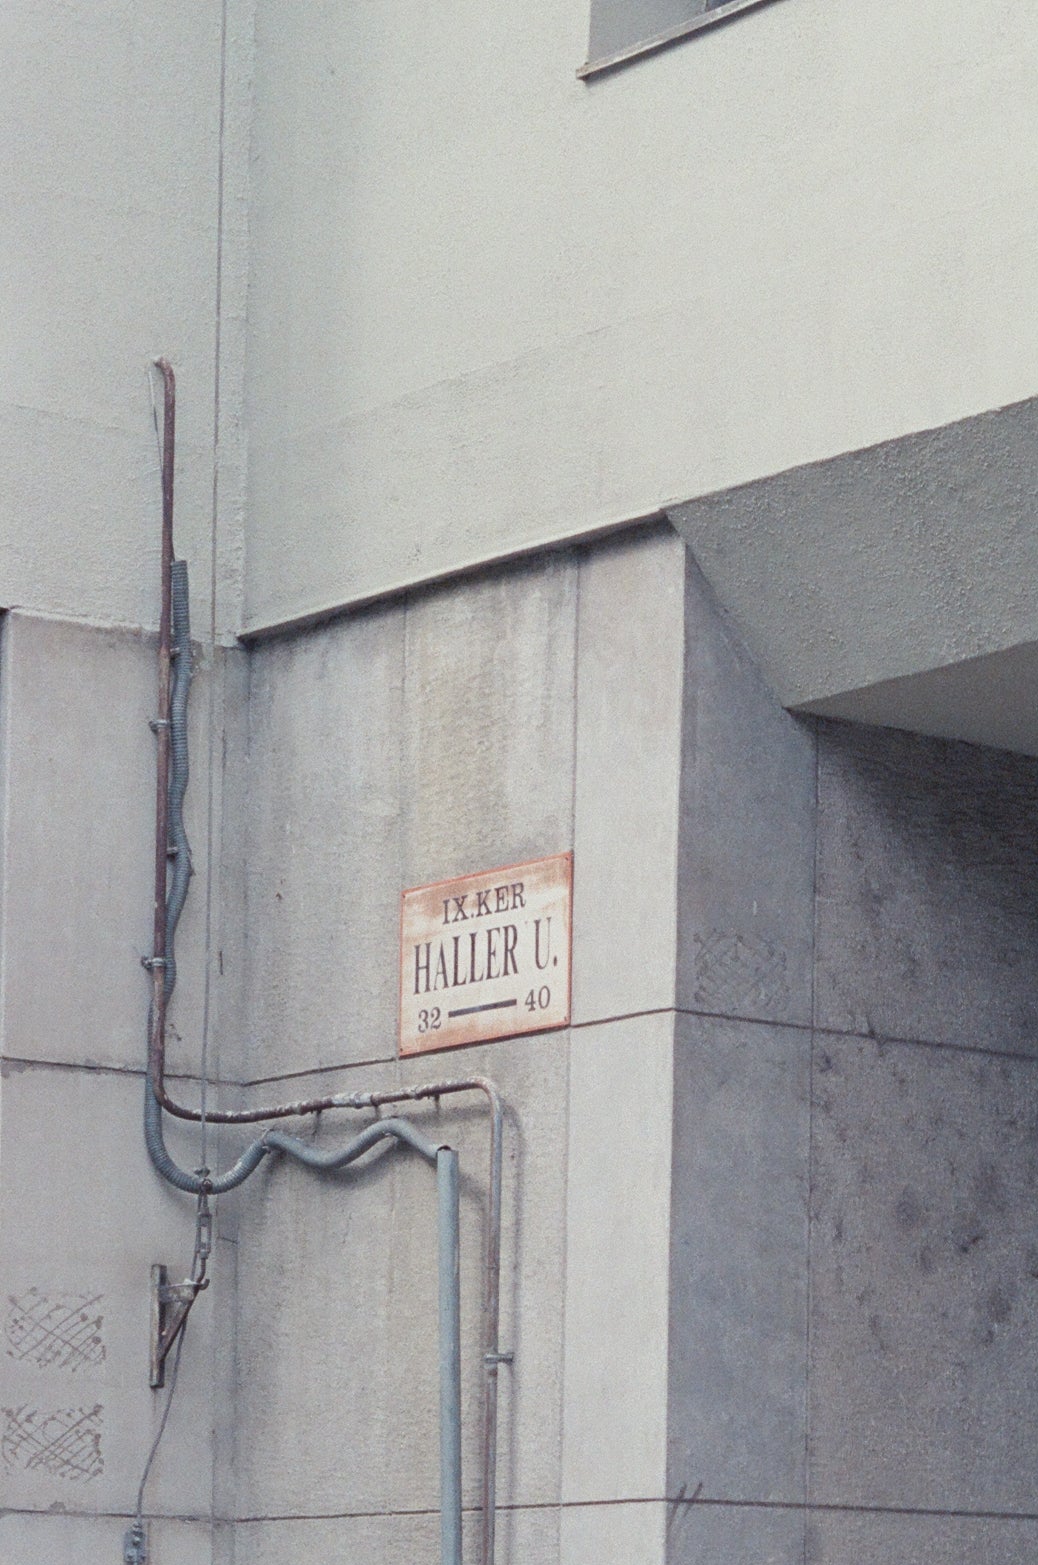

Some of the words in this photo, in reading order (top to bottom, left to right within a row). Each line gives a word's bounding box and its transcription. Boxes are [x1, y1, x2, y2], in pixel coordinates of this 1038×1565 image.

[413, 924, 519, 995] HALLER
[534, 917, 558, 970] U.
[417, 1006, 442, 1033] 32
[524, 985, 550, 1012] 40
